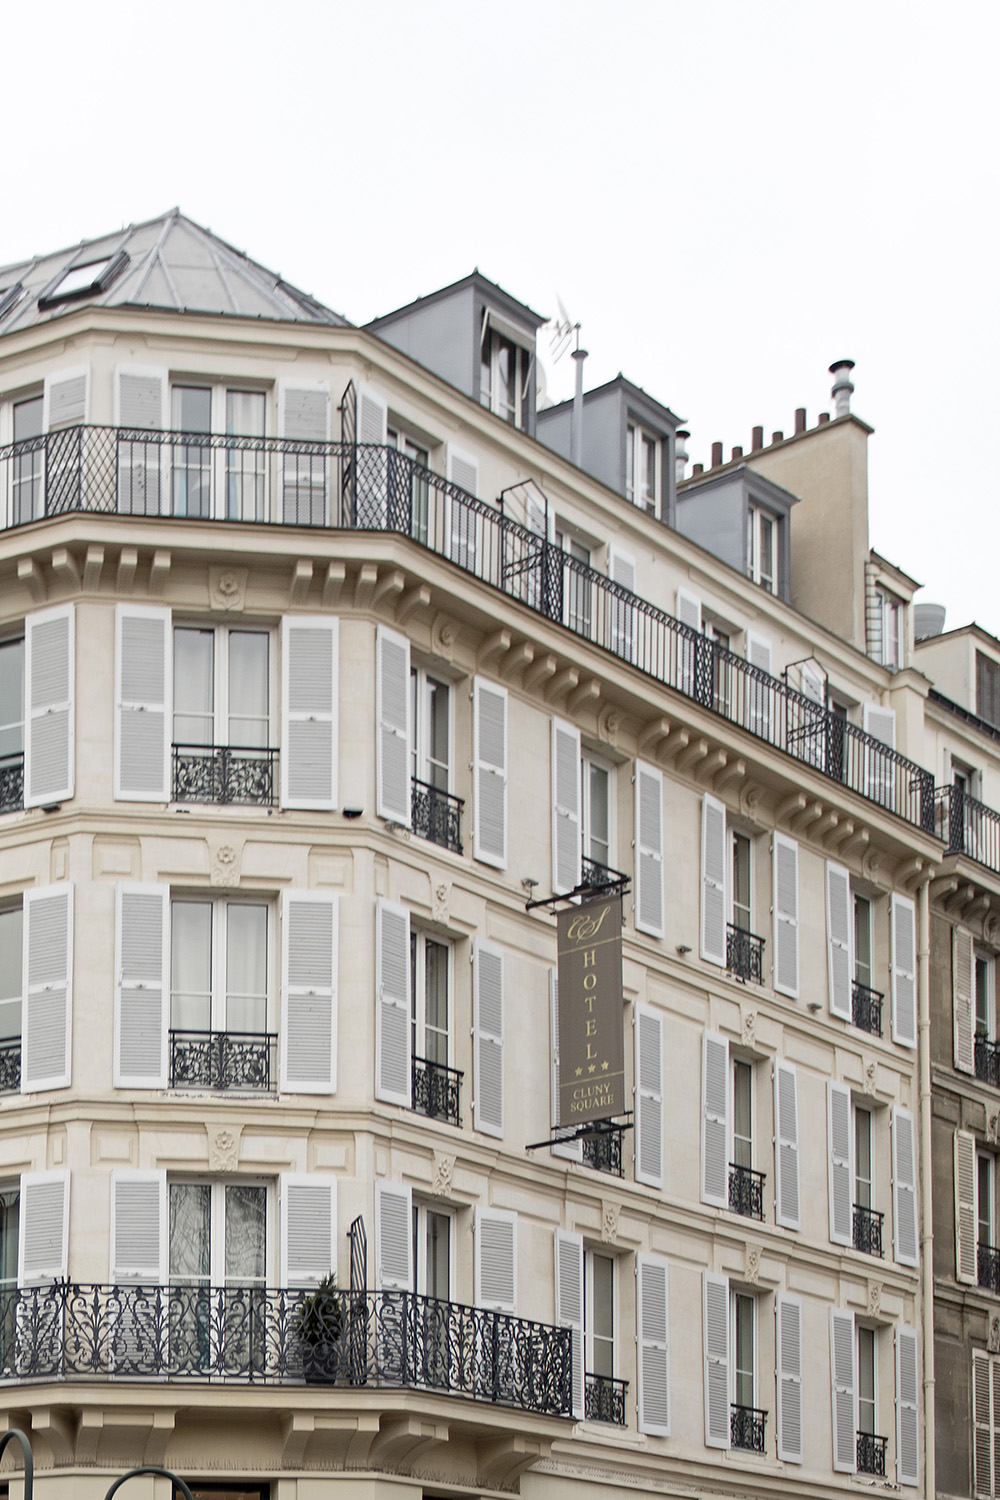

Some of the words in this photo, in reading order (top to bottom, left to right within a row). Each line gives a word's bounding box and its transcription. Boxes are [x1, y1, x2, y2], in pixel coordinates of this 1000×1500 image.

[582, 950, 598, 1060] HOTEL
[573, 1082, 611, 1100] CLUNY
[570, 1094, 615, 1113] SQUARE
